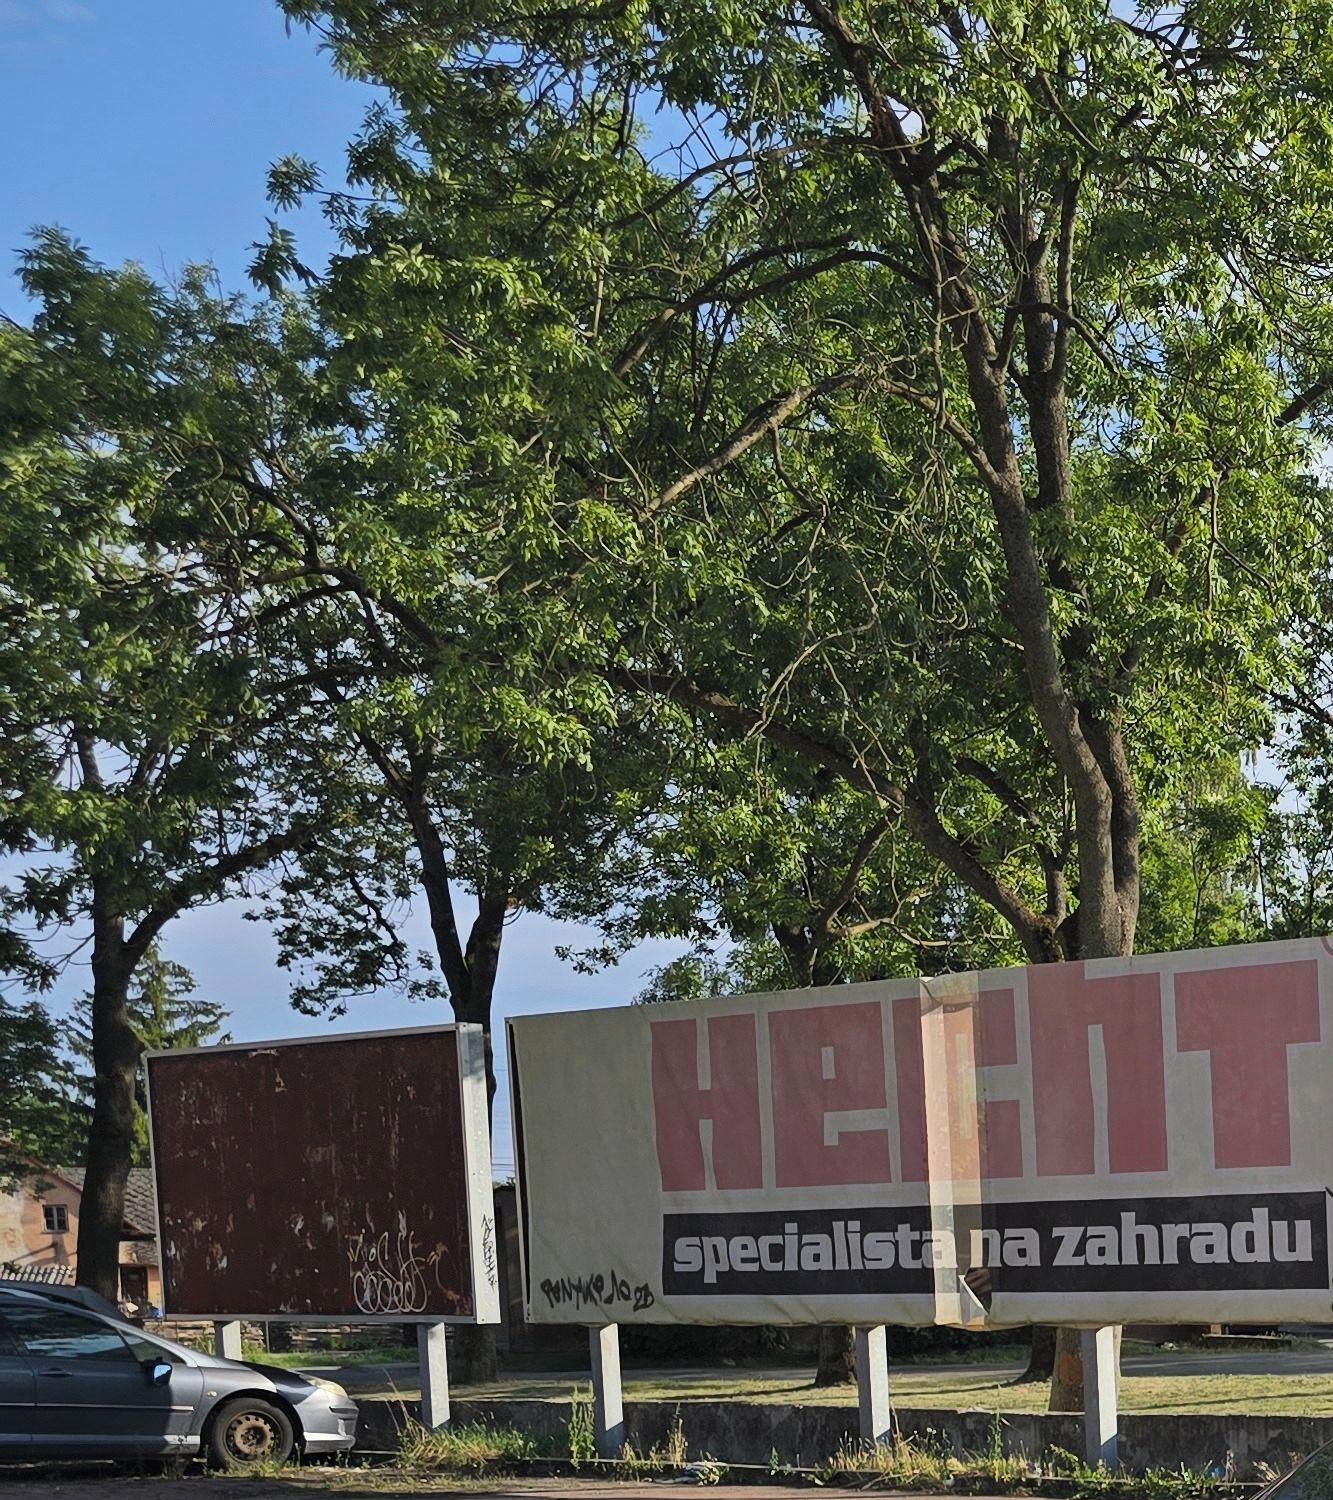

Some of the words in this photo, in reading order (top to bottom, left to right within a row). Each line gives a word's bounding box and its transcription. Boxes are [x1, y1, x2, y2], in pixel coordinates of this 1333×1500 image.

[673, 1221, 958, 1283] specialista
[969, 1227, 1041, 1268] na
[1051, 1208, 1313, 1267] zahradu
